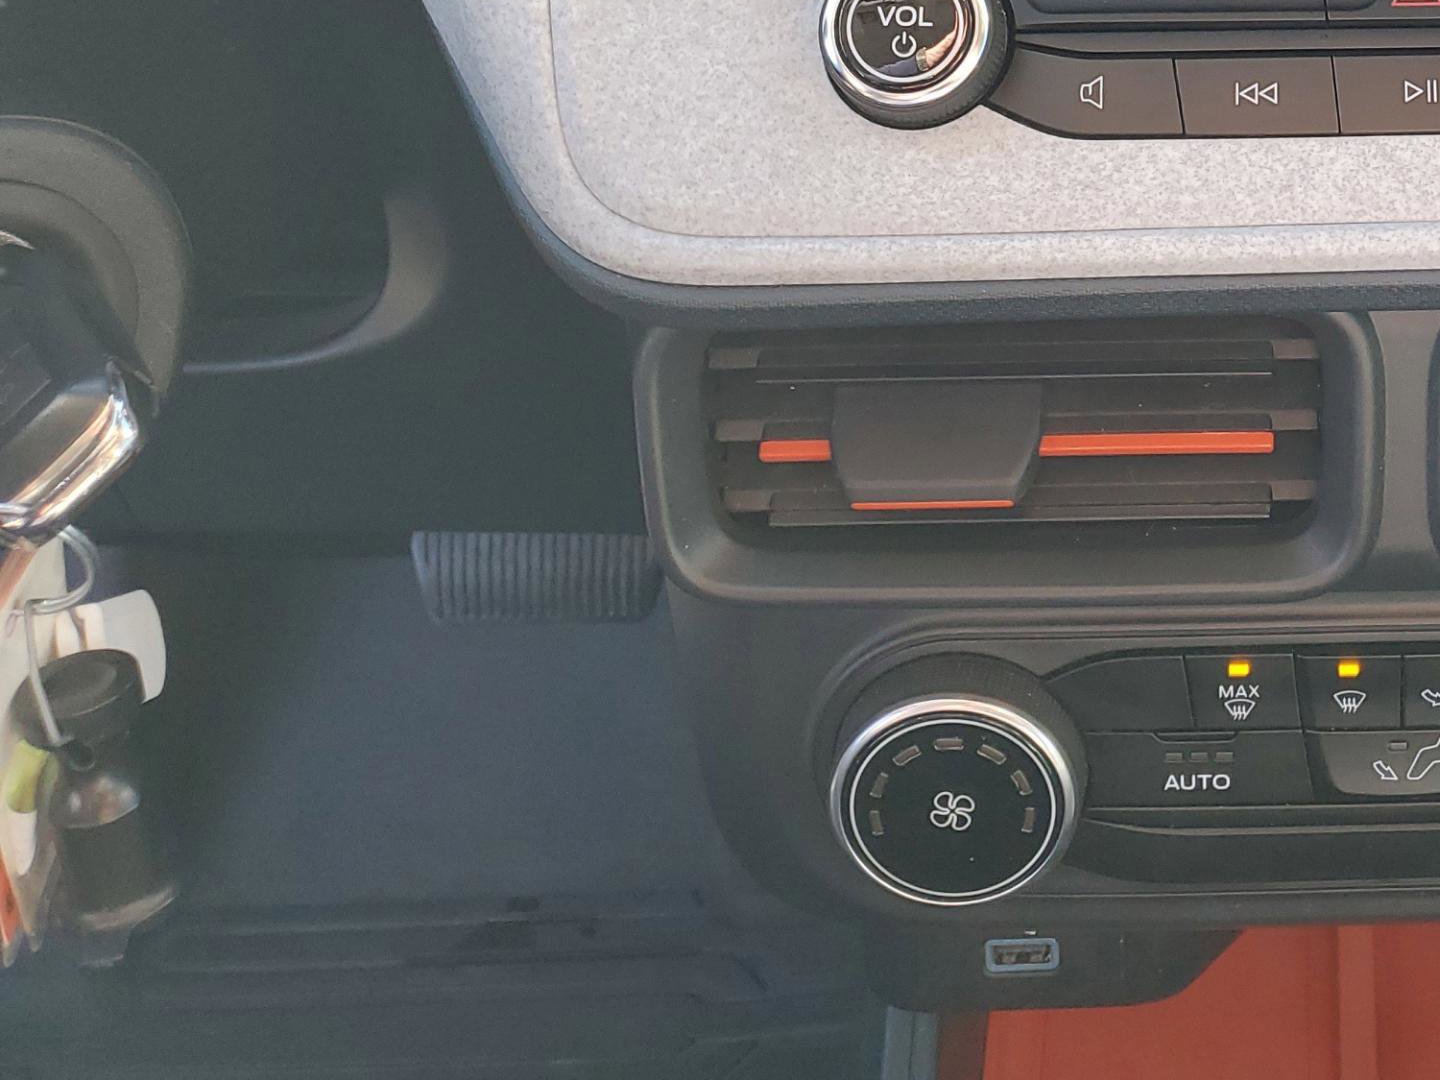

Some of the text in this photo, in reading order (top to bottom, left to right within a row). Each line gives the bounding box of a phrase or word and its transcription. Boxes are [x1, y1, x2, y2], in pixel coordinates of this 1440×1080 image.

[876, 5, 934, 28] VOL
[1218, 684, 1261, 699] MAX
[1163, 773, 1232, 791] AUTO
